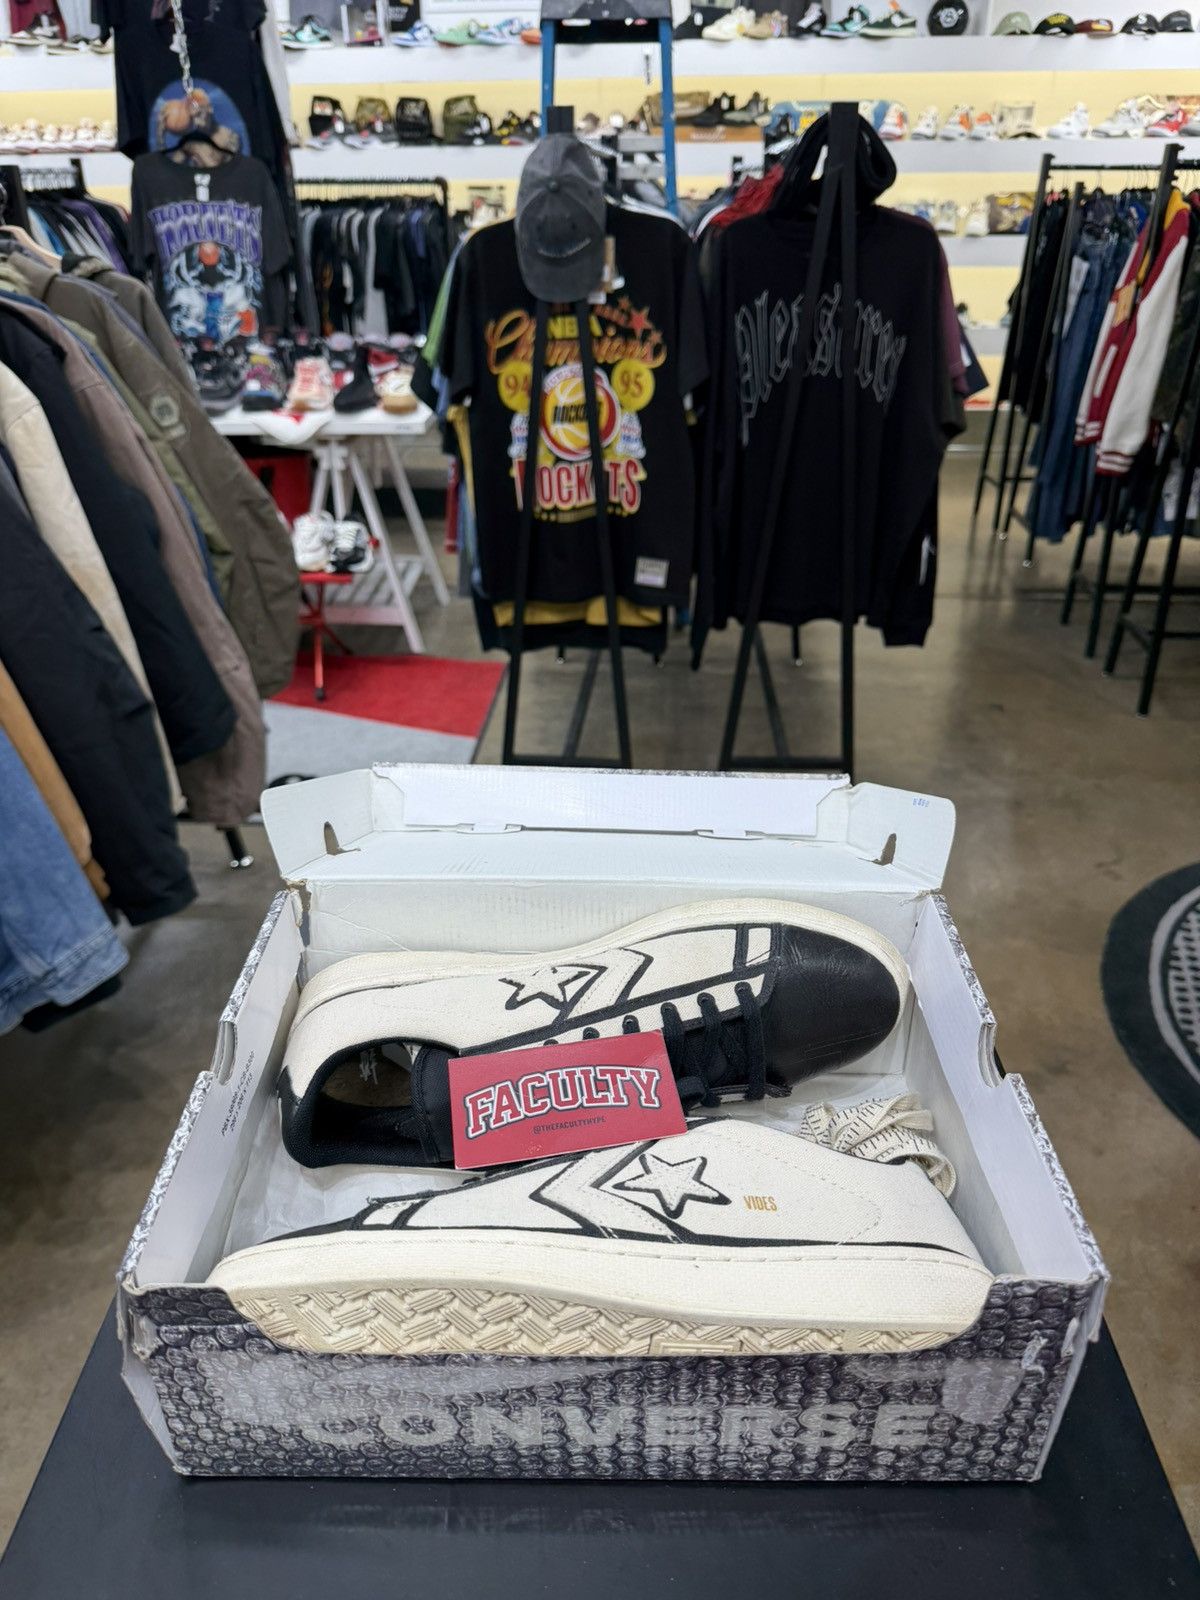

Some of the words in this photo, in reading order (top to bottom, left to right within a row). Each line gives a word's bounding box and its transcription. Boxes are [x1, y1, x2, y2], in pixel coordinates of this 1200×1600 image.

[620, 371, 645, 399] 95
[513, 458, 641, 514] OCKTS
[465, 1065, 661, 1139] FACULTY
[533, 1115, 606, 1134] @THEFACULTYHYPE
[298, 1403, 938, 1447] CONVERSE
